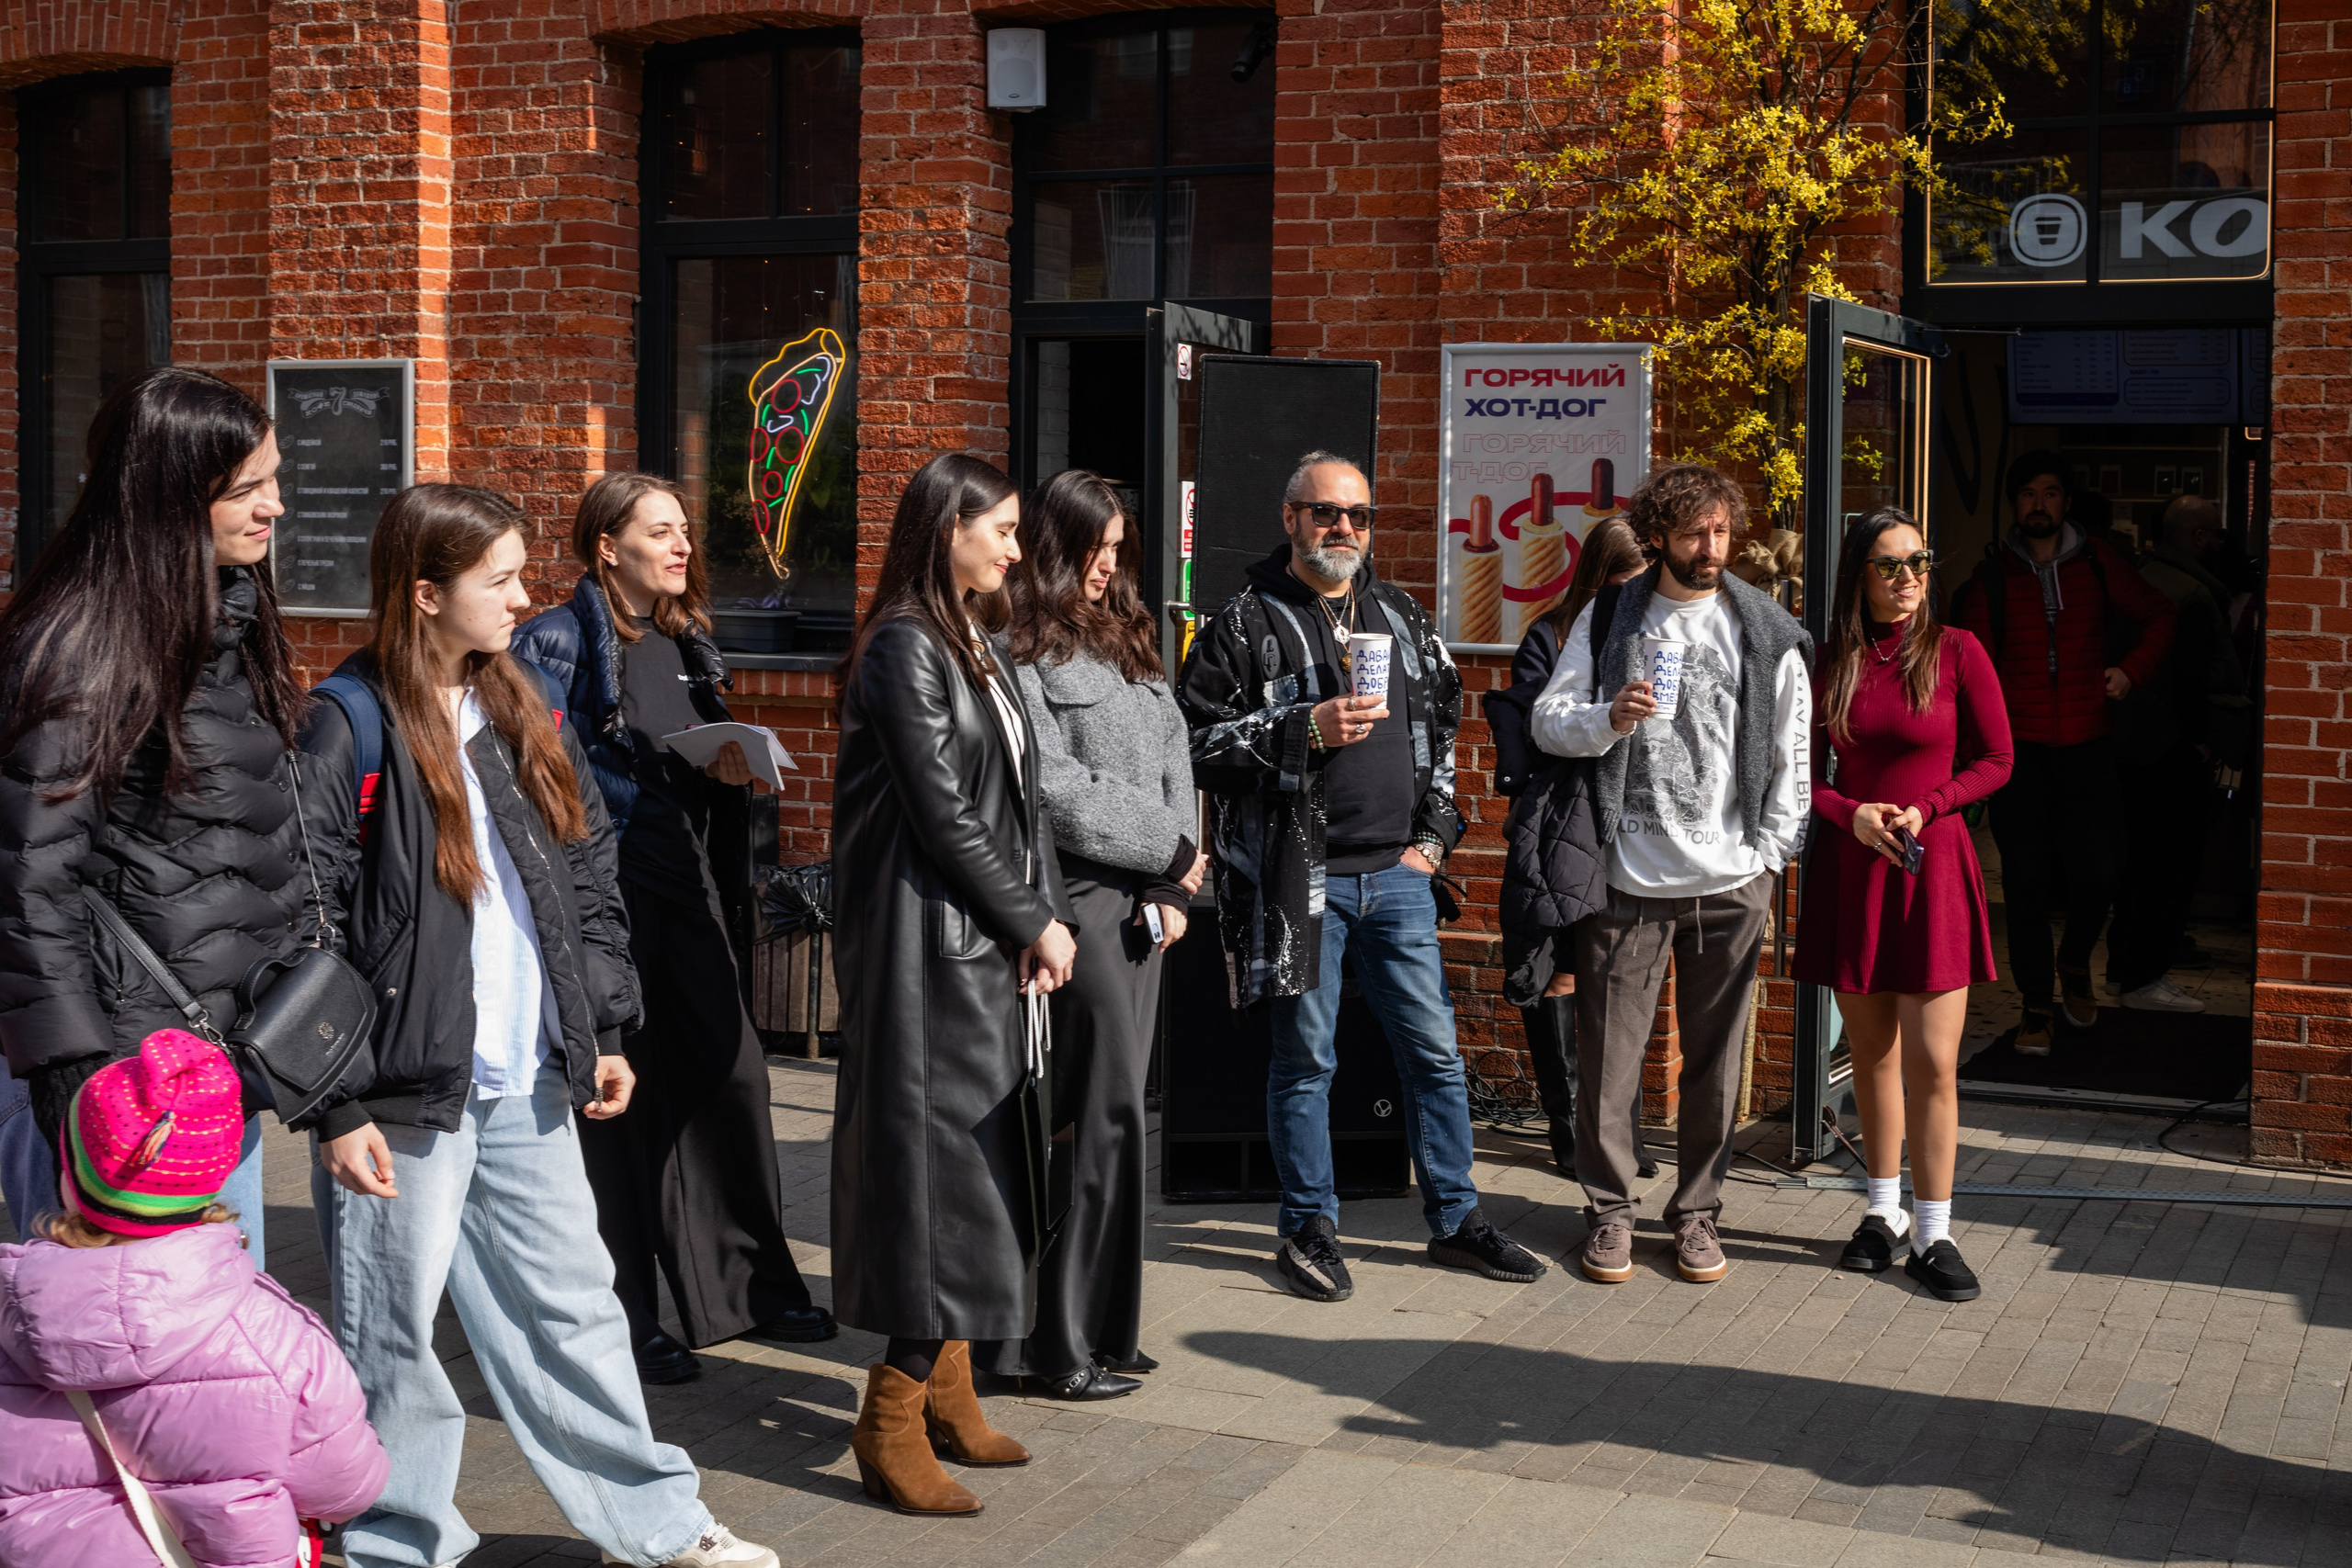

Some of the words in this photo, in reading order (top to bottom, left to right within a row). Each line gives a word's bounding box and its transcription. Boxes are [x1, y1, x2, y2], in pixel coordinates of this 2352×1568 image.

[1464, 364, 1625, 388] ГОРЯЧИЙ
[1464, 398, 1607, 420] ХОТ-ДОГ
[1463, 429, 1627, 455] ГОРЯЧИЙ
[1449, 461, 1548, 484] Т-ДОГ
[1653, 677, 1679, 691] ДОБ
[1792, 731, 1808, 773] ALL
[1796, 780, 1811, 811] BE
[1683, 828, 1721, 845] TOUR
